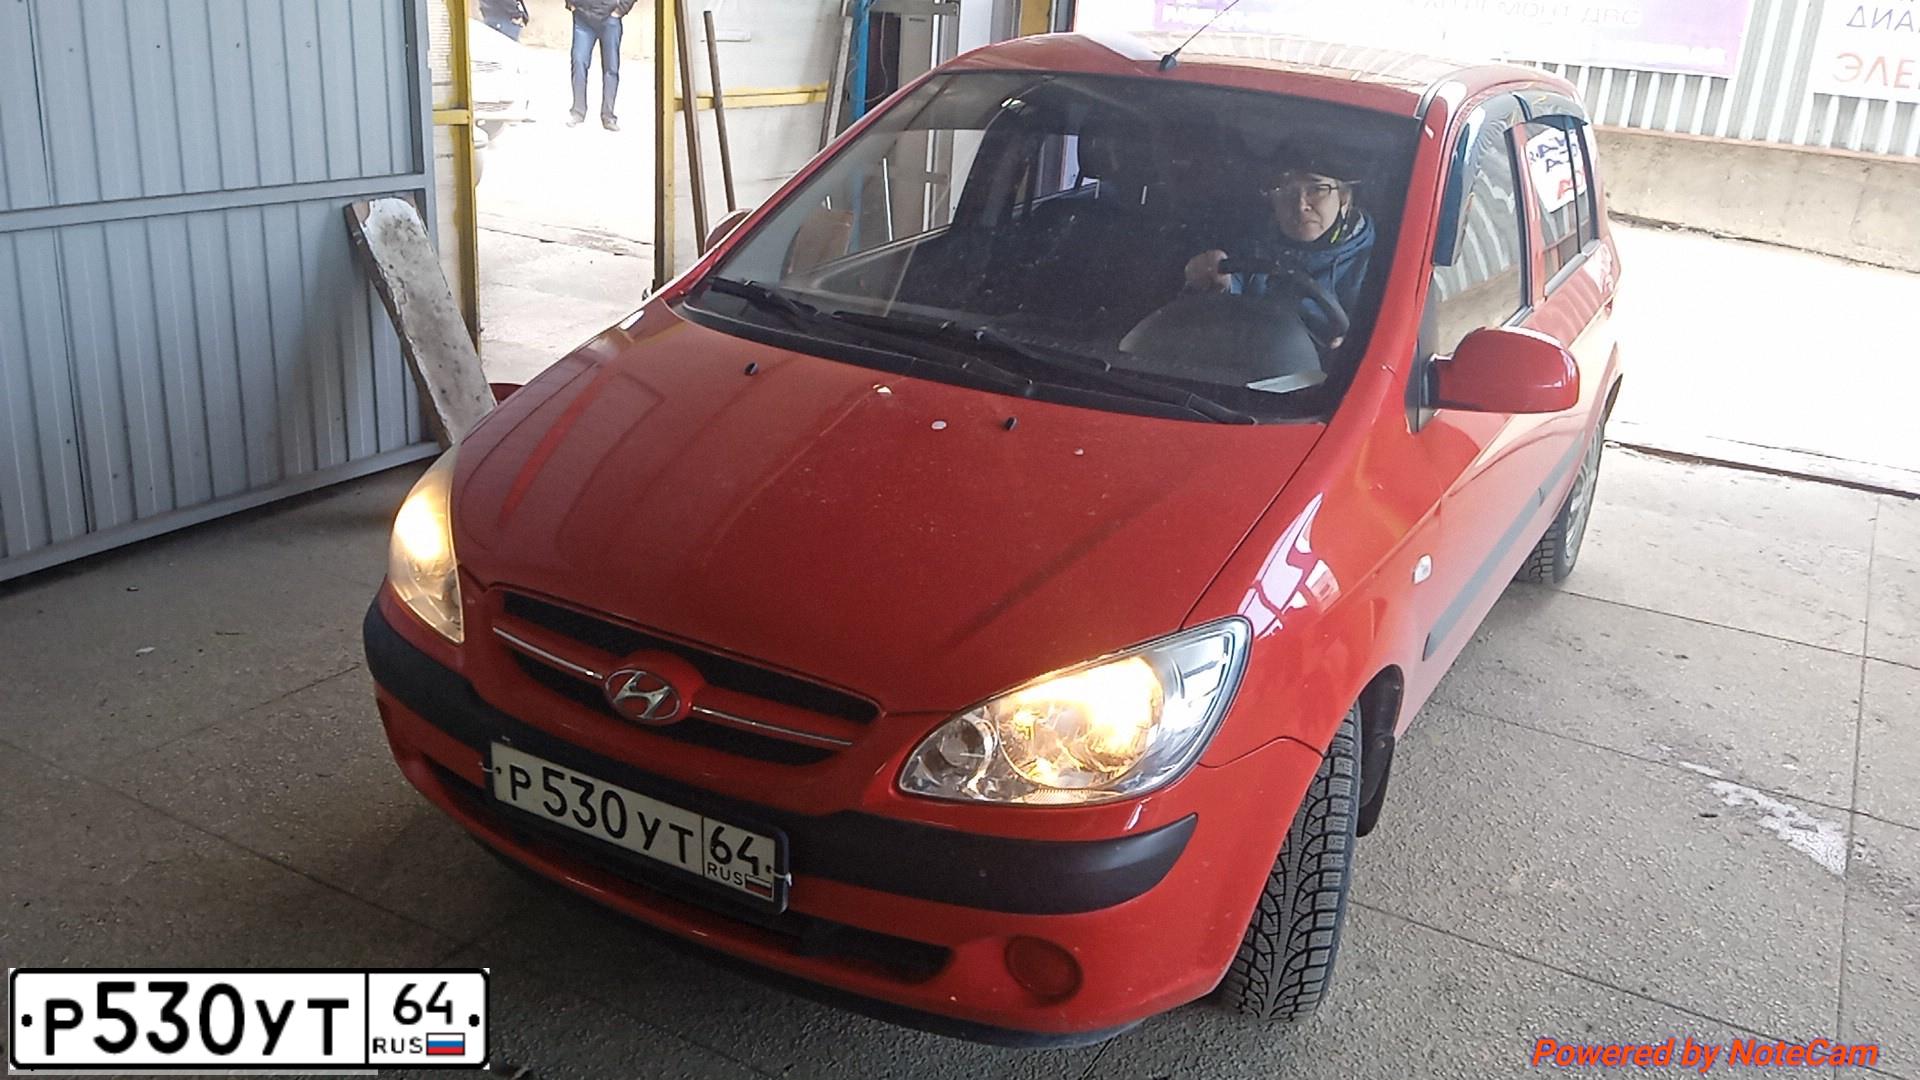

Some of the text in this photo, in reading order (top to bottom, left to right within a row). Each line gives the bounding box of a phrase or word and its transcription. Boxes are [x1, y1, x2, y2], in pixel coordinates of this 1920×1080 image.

[1845, 5, 1920, 33] ДИА
[1832, 52, 1920, 90] ЭЛЕ
[709, 825, 761, 877] 64
[707, 862, 743, 887] RUS
